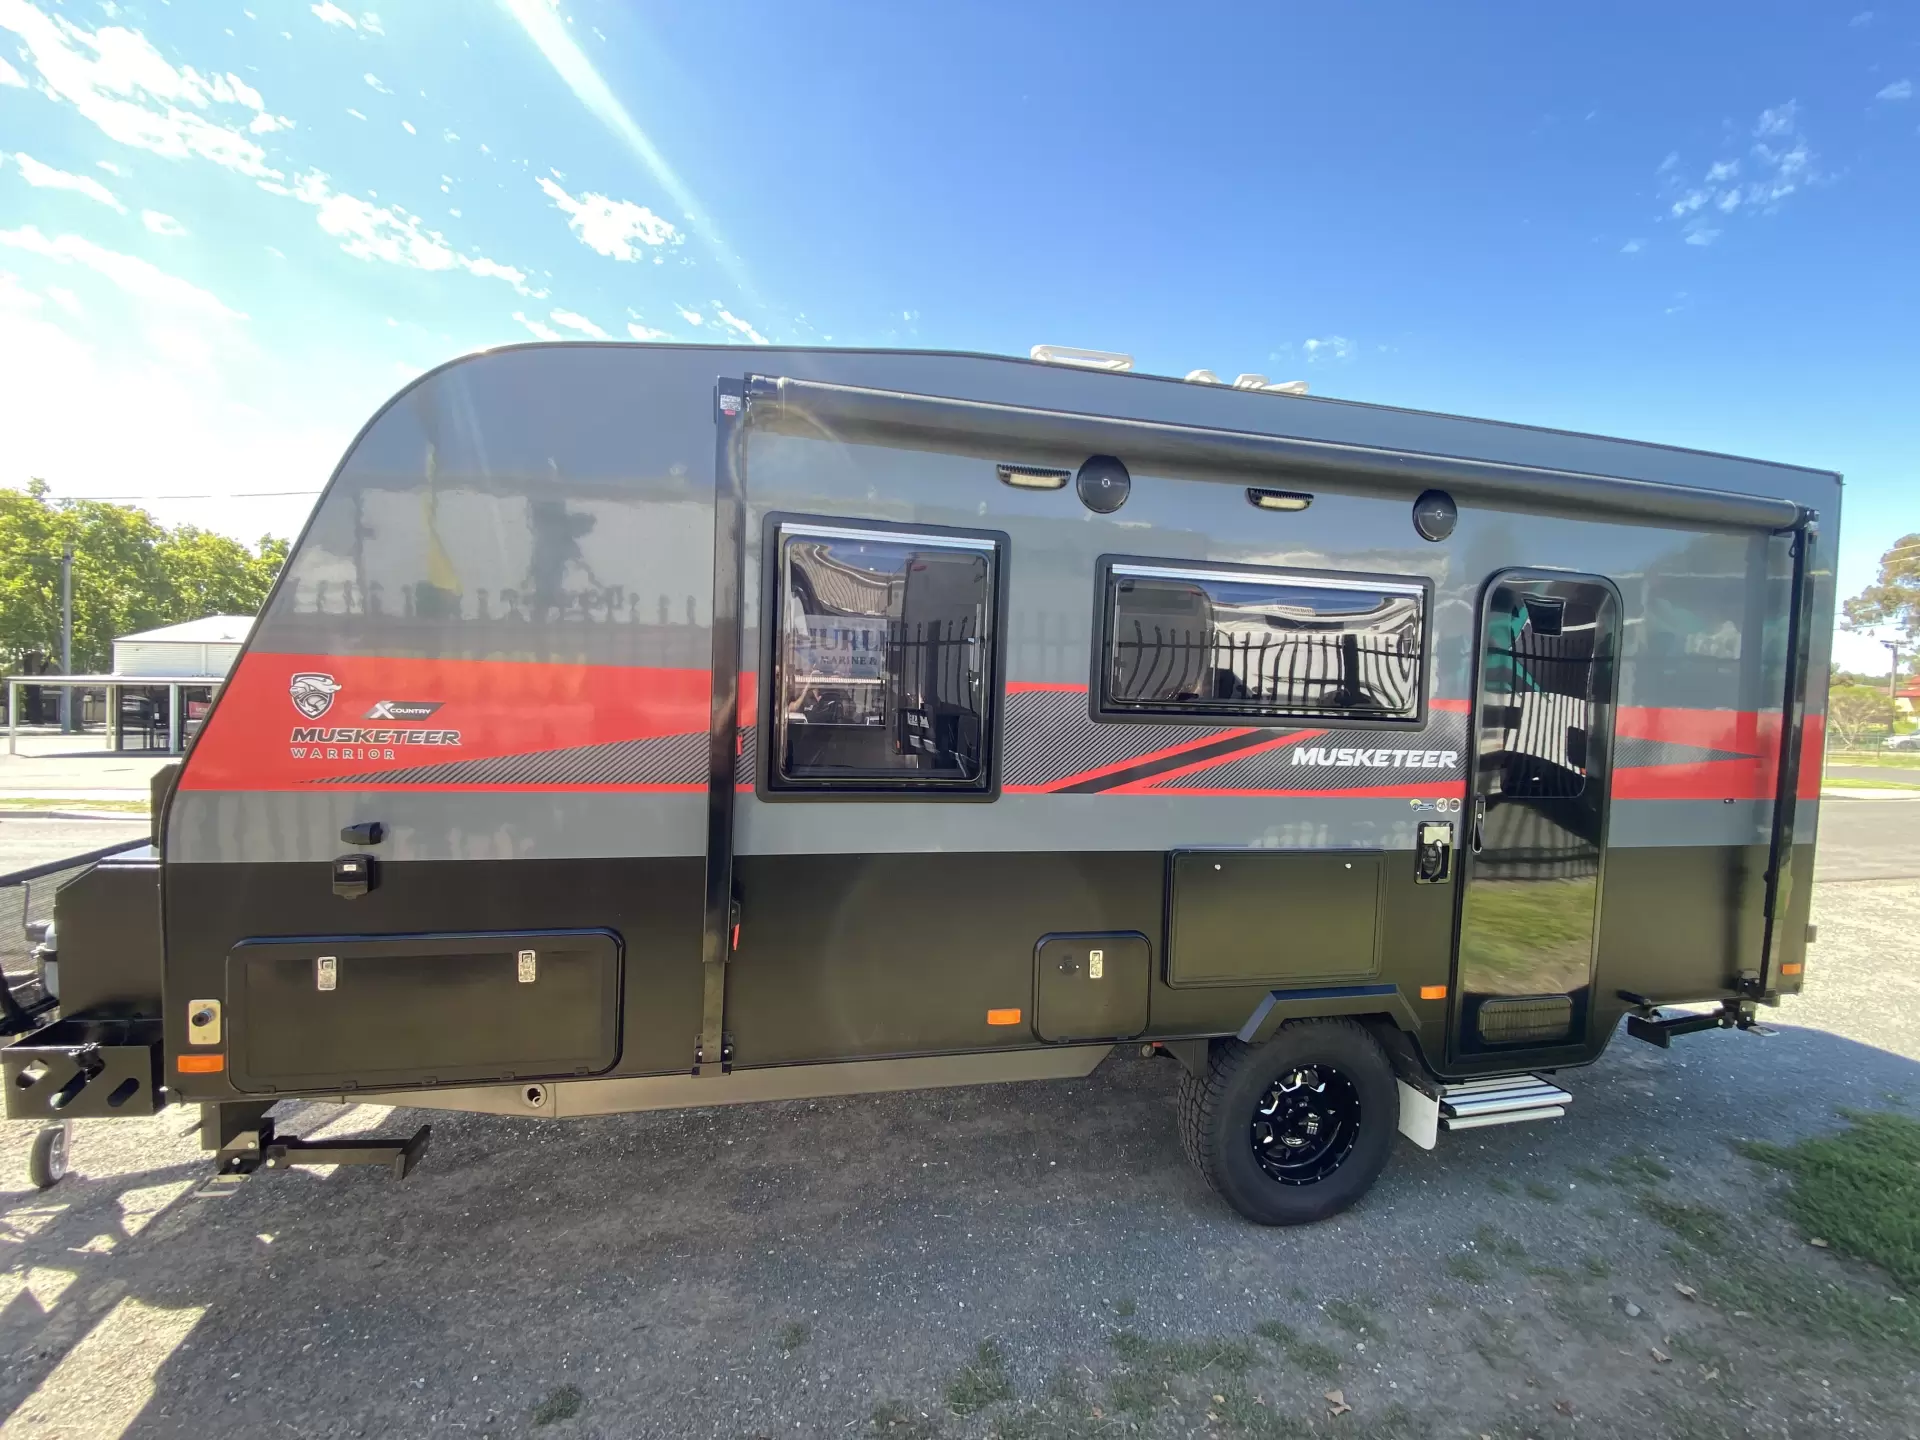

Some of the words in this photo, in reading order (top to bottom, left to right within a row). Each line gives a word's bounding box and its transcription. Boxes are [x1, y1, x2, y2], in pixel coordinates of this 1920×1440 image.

[820, 656, 867, 666] MARINE
[290, 727, 462, 746] MUSKETEER
[291, 748, 395, 760] WARRIOR
[1291, 747, 1458, 768] MUSKETEER
